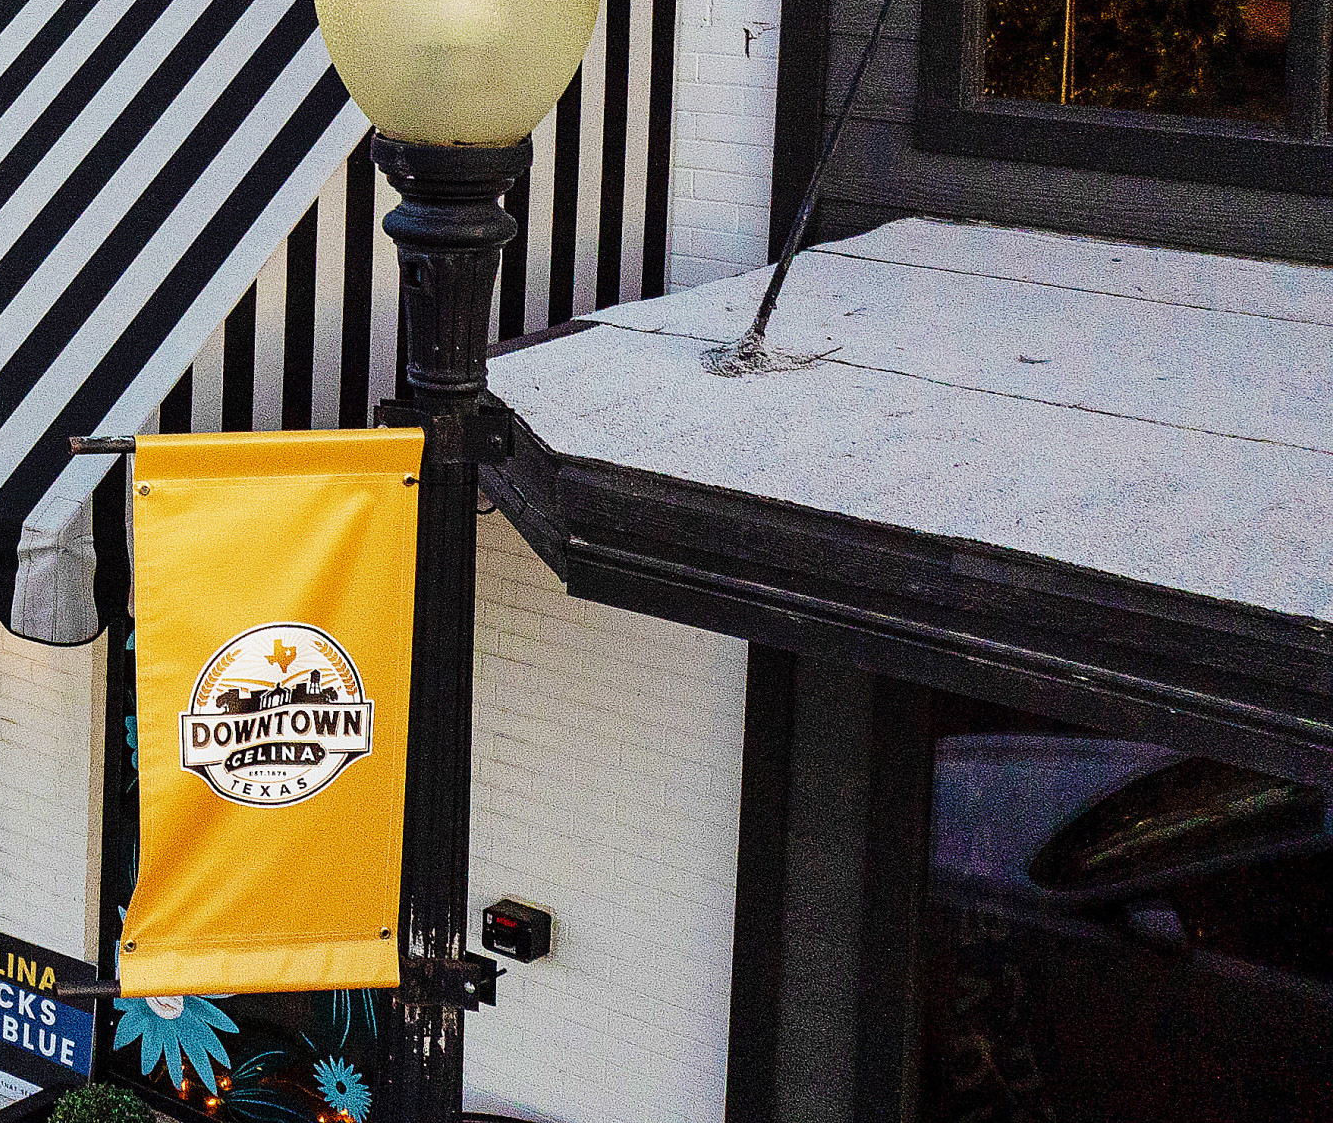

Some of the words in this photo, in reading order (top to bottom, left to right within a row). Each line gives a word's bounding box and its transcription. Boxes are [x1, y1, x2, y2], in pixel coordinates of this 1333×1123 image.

[191, 710, 362, 749] DOWNTOWN
[231, 745, 316, 768] CELINA
[232, 777, 308, 797] TEXAS
[2, 1014, 76, 1067] BLUE
